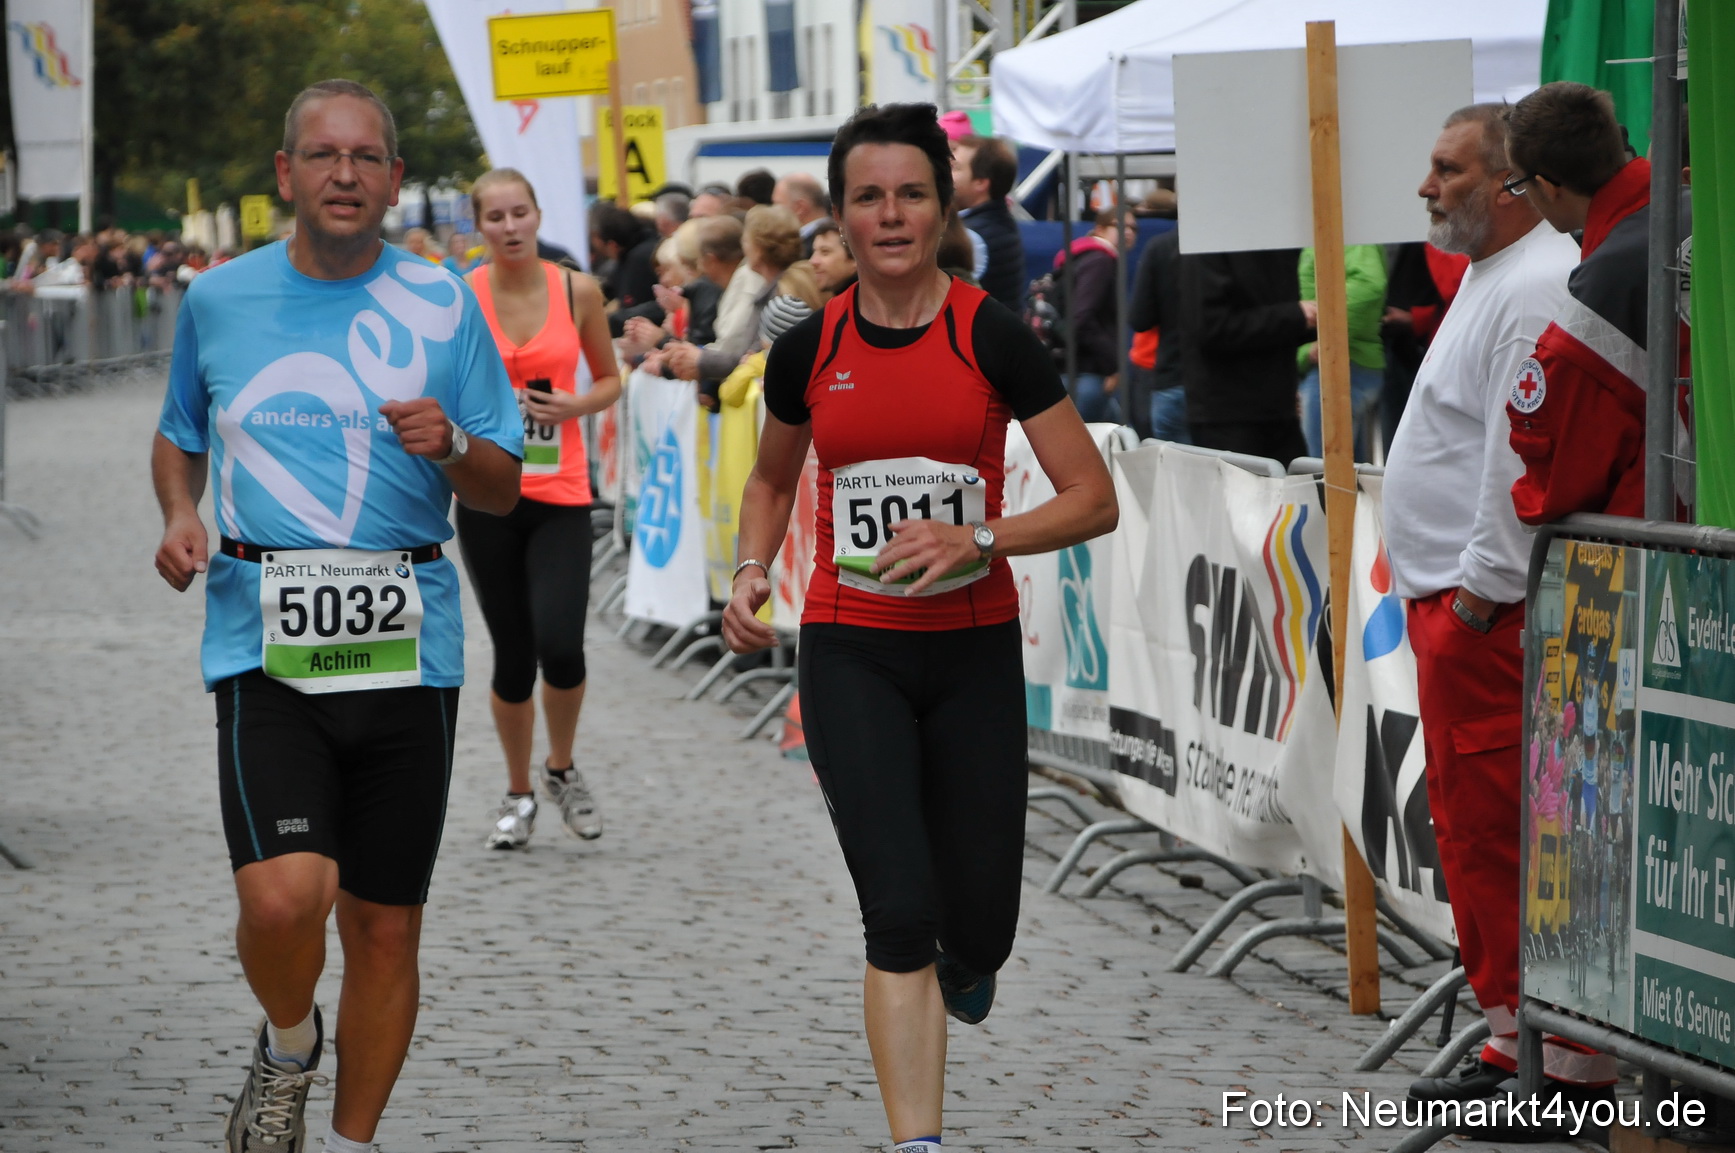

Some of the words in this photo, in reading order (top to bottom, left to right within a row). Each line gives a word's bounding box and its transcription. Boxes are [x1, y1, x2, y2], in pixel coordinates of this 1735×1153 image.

[498, 36, 606, 56] Schnupper-
[536, 58, 570, 76] lauf
[605, 109, 657, 128] Bock
[829, 382, 855, 391] erima
[1527, 388, 1544, 408] KREUZ
[251, 408, 332, 428] anders
[338, 410, 371, 430] als
[836, 476, 882, 490] PARTL
[886, 471, 957, 487] Neumarkt
[265, 565, 316, 579] PARTL
[321, 564, 391, 577] Neumarkt
[279, 585, 407, 638] 5032
[1577, 598, 1611, 645] erdgas
[310, 651, 371, 672] Achim
[1648, 740, 1702, 815] Mehr
[277, 825, 309, 834] SPEED
[1645, 834, 1678, 910] für
[1681, 845, 1708, 919] Ihr
[1642, 976, 1671, 1024] Miet
[1674, 986, 1684, 1028] &
[1687, 990, 1731, 1044] Service
